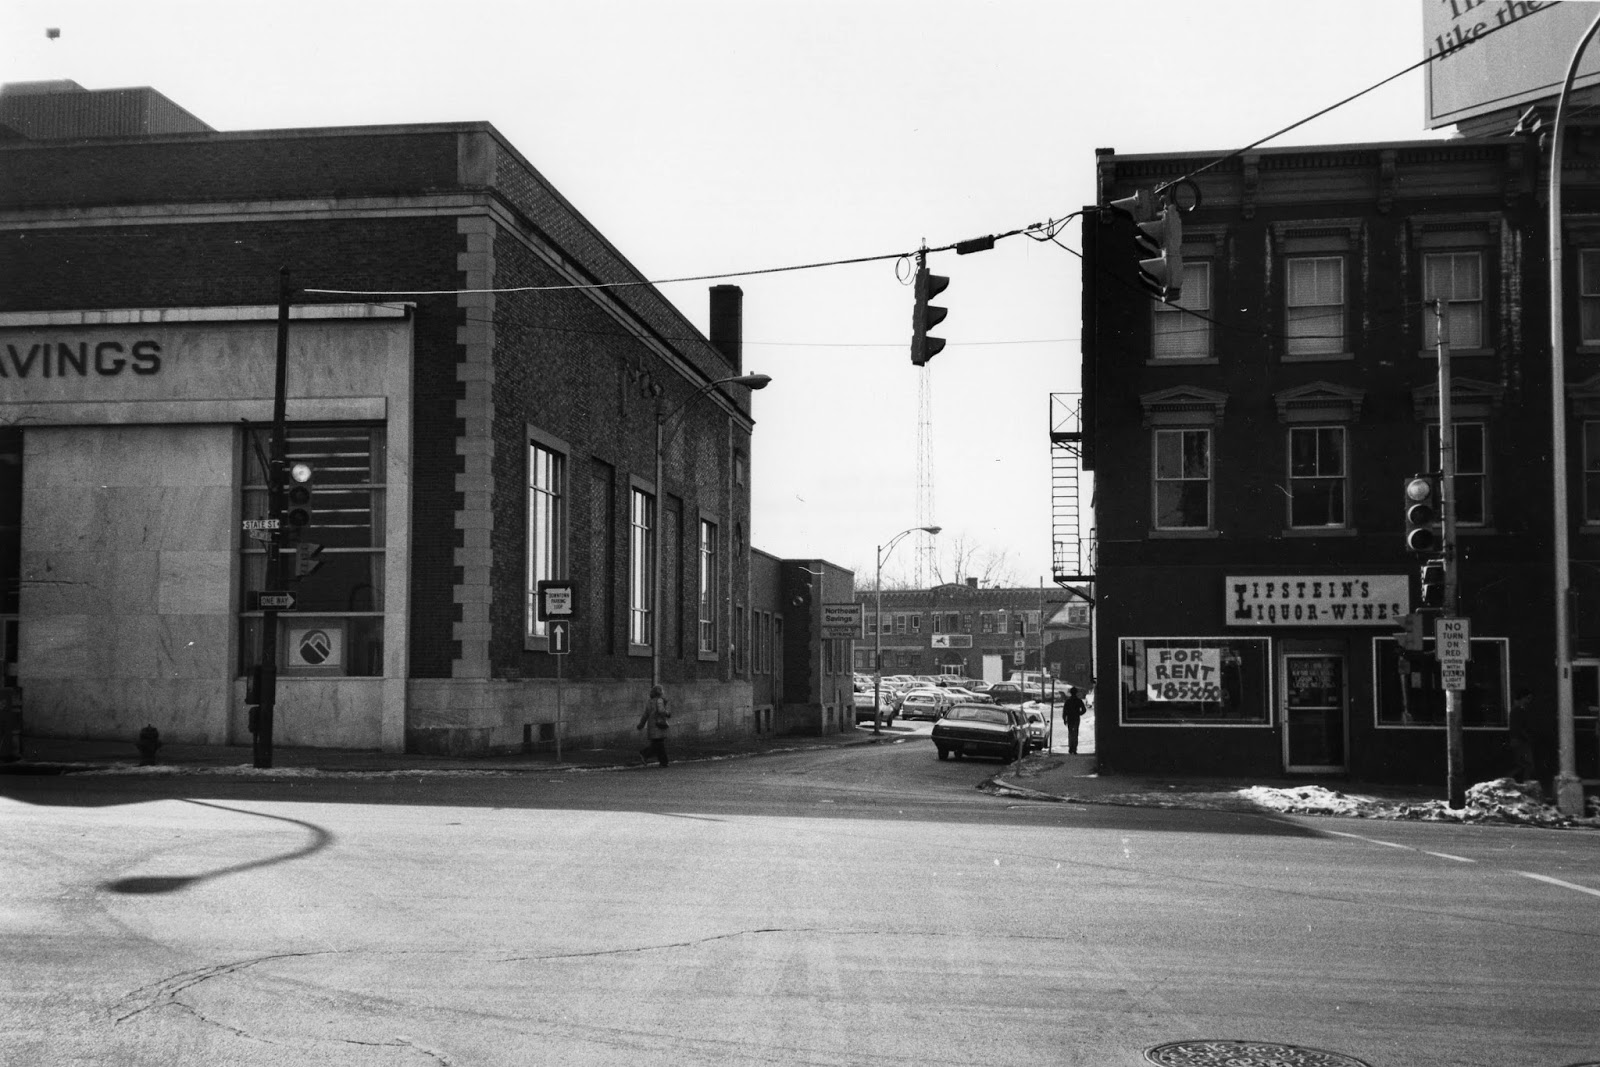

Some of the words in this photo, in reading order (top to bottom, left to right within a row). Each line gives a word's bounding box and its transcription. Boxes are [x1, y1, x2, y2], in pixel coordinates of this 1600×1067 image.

[1435, 22, 1488, 61] like
[0, 341, 161, 378] VINGS
[245, 520, 266, 529] STATE
[261, 597, 274, 605] ONE
[276, 597, 288, 605] WAY
[825, 615, 852, 623] Savings
[1445, 623, 1461, 631] NO
[1443, 632, 1464, 640] TURN
[1160, 650, 1203, 663] FOR
[1445, 649, 1461, 657] RED
[1155, 664, 1215, 681] RENT
